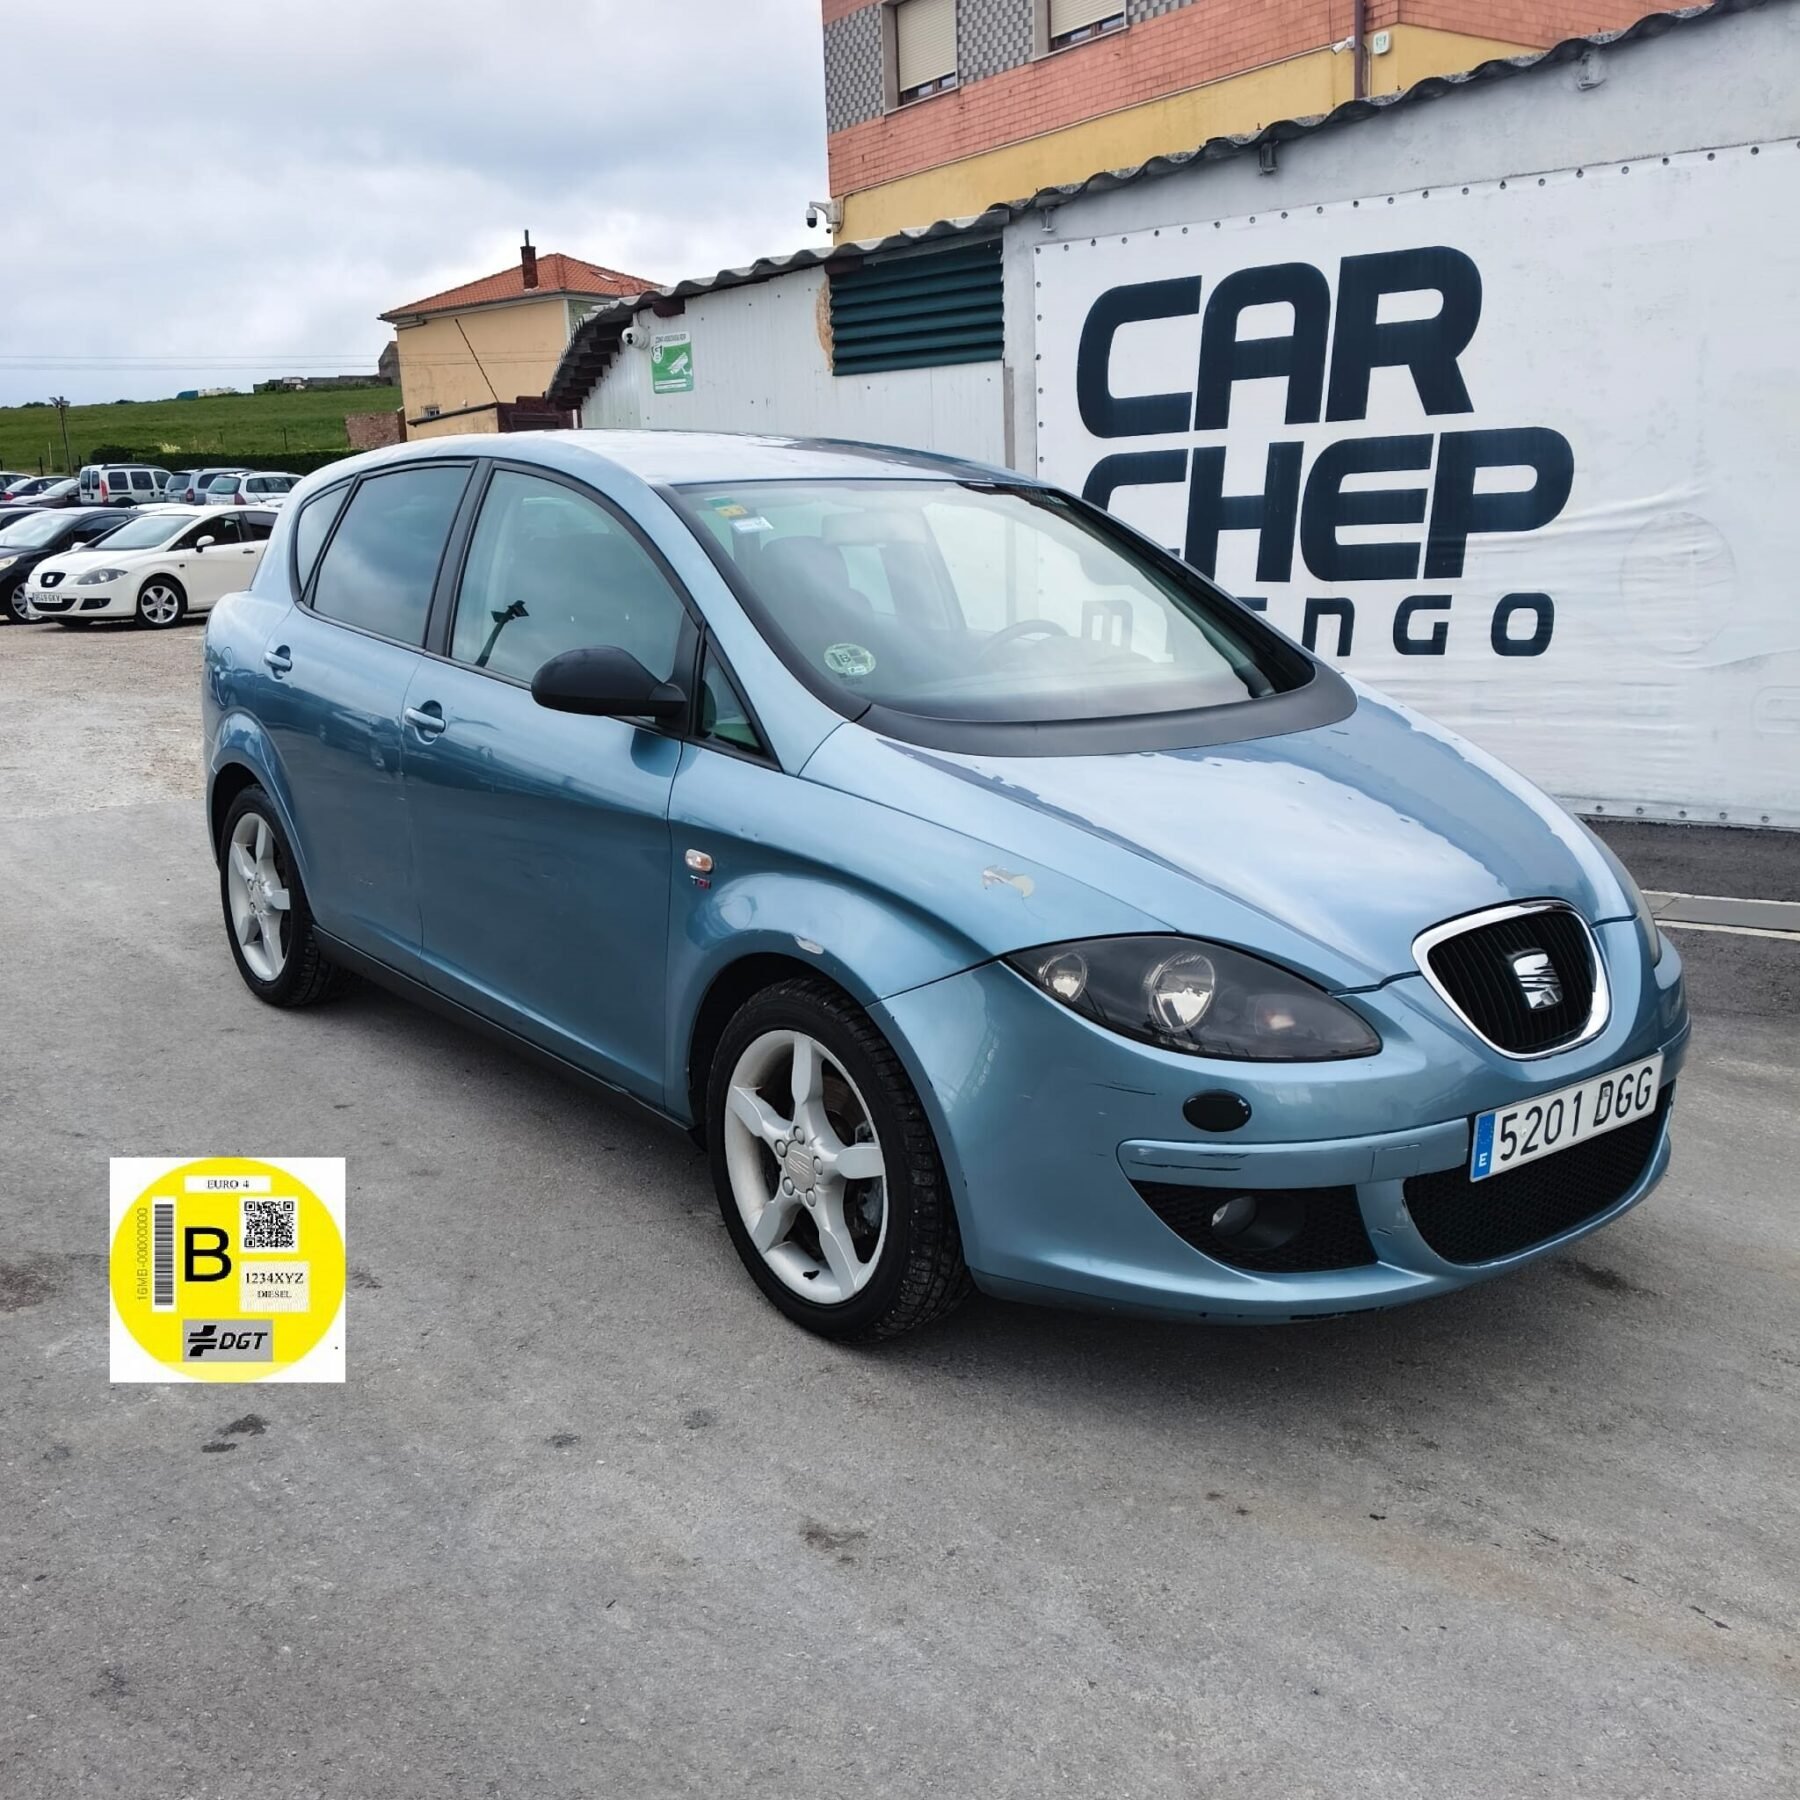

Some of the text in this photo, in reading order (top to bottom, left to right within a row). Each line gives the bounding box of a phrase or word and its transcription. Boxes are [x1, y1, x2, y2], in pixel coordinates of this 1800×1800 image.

[1077, 246, 1482, 438] CAR
[1081, 426, 1574, 582] CHEP
[1478, 1152, 1488, 1168] E
[1500, 1066, 1653, 1161] 5201 DGG
